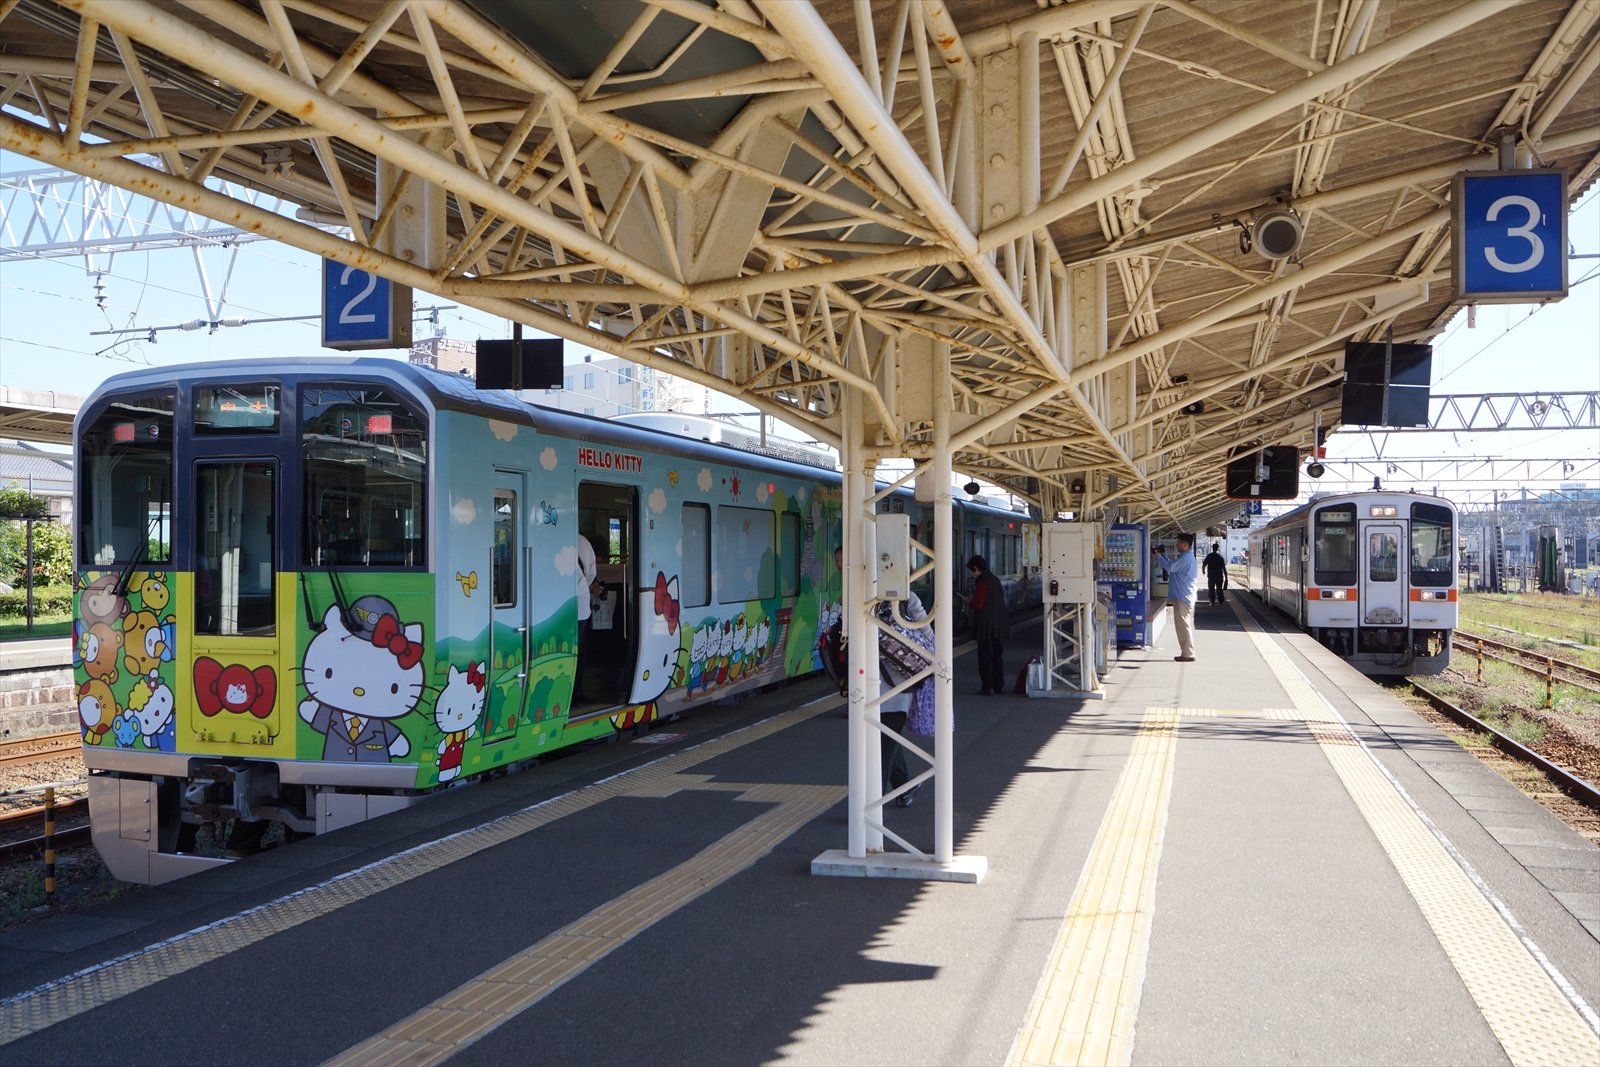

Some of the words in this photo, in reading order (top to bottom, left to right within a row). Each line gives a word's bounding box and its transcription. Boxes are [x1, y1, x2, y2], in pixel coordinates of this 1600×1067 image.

[1484, 195, 1544, 273] 3
[339, 266, 377, 325] 2
[578, 447, 612, 469] HELLO
[614, 453, 643, 473] KITTY
